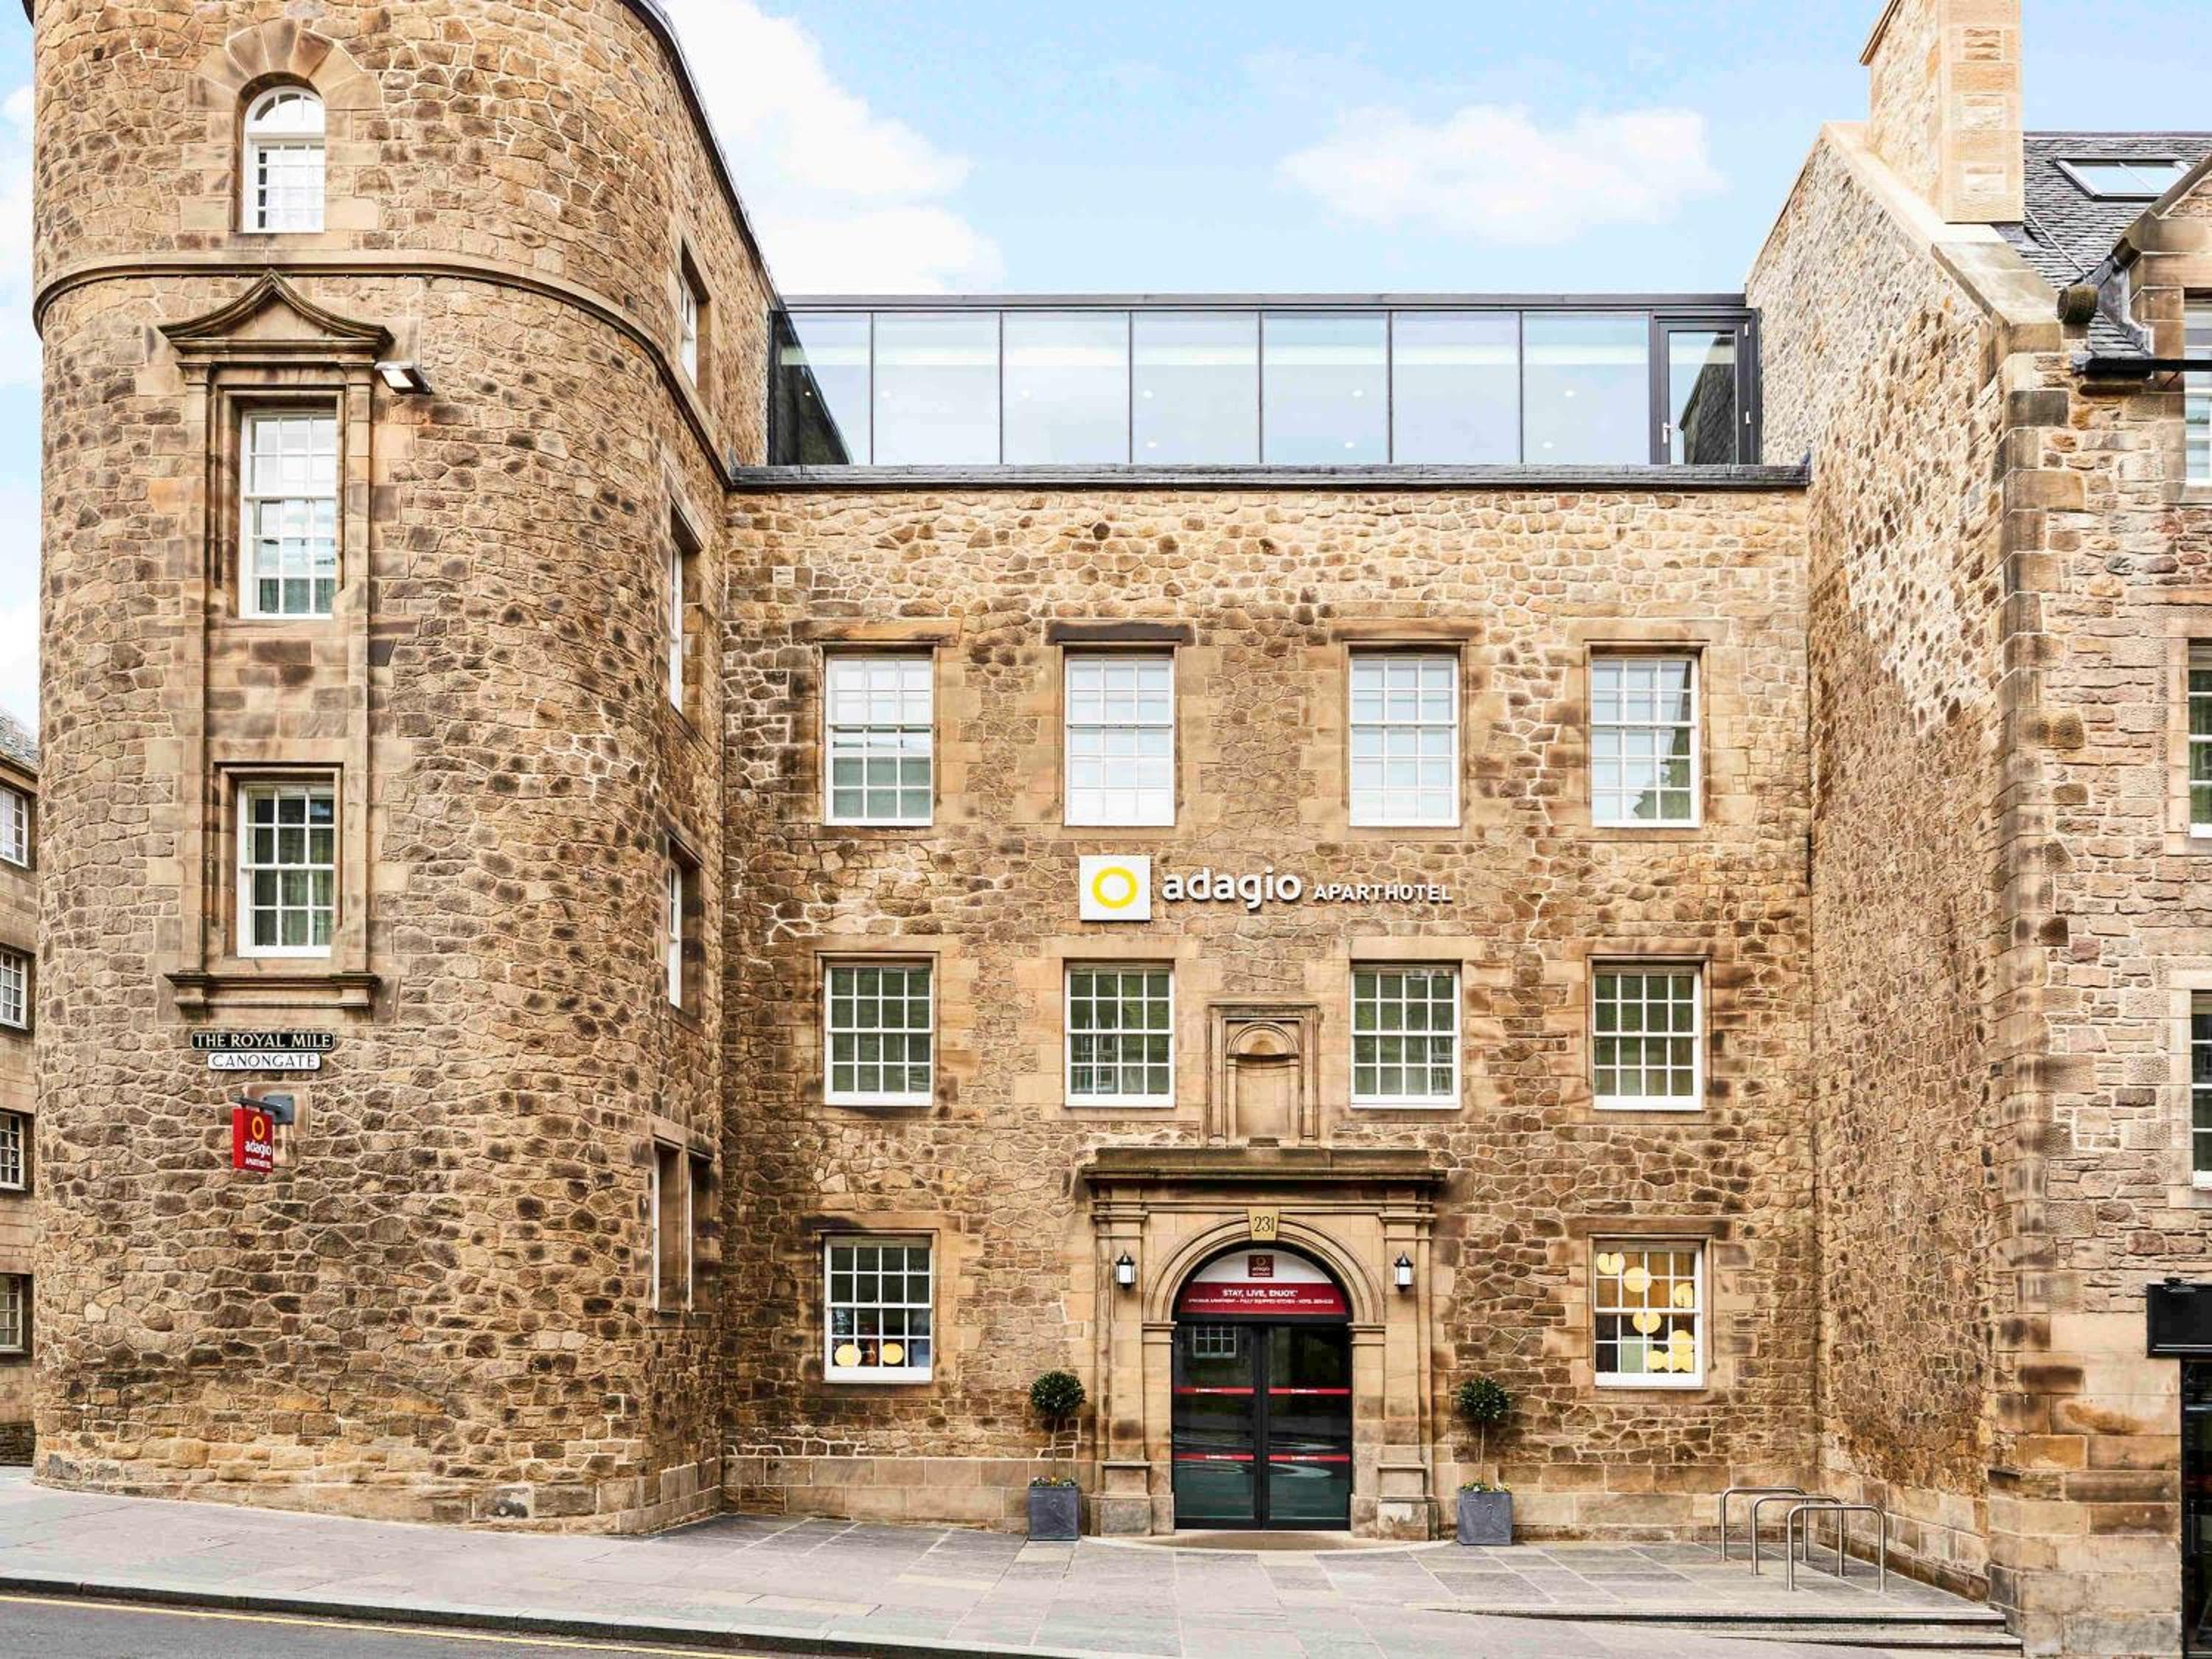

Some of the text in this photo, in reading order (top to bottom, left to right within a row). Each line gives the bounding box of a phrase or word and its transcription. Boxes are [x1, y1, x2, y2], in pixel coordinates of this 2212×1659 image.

[1162, 866, 1453, 909] adagio APARTHOTEL
[195, 1034, 330, 1047] THE ROYAL MILE
[212, 1054, 315, 1067] CANONGATE
[245, 1139, 271, 1158] adagio
[1254, 1216, 1274, 1231] 231
[1222, 1289, 1244, 1298] STAY,
[1246, 1289, 1267, 1298] LIVE,
